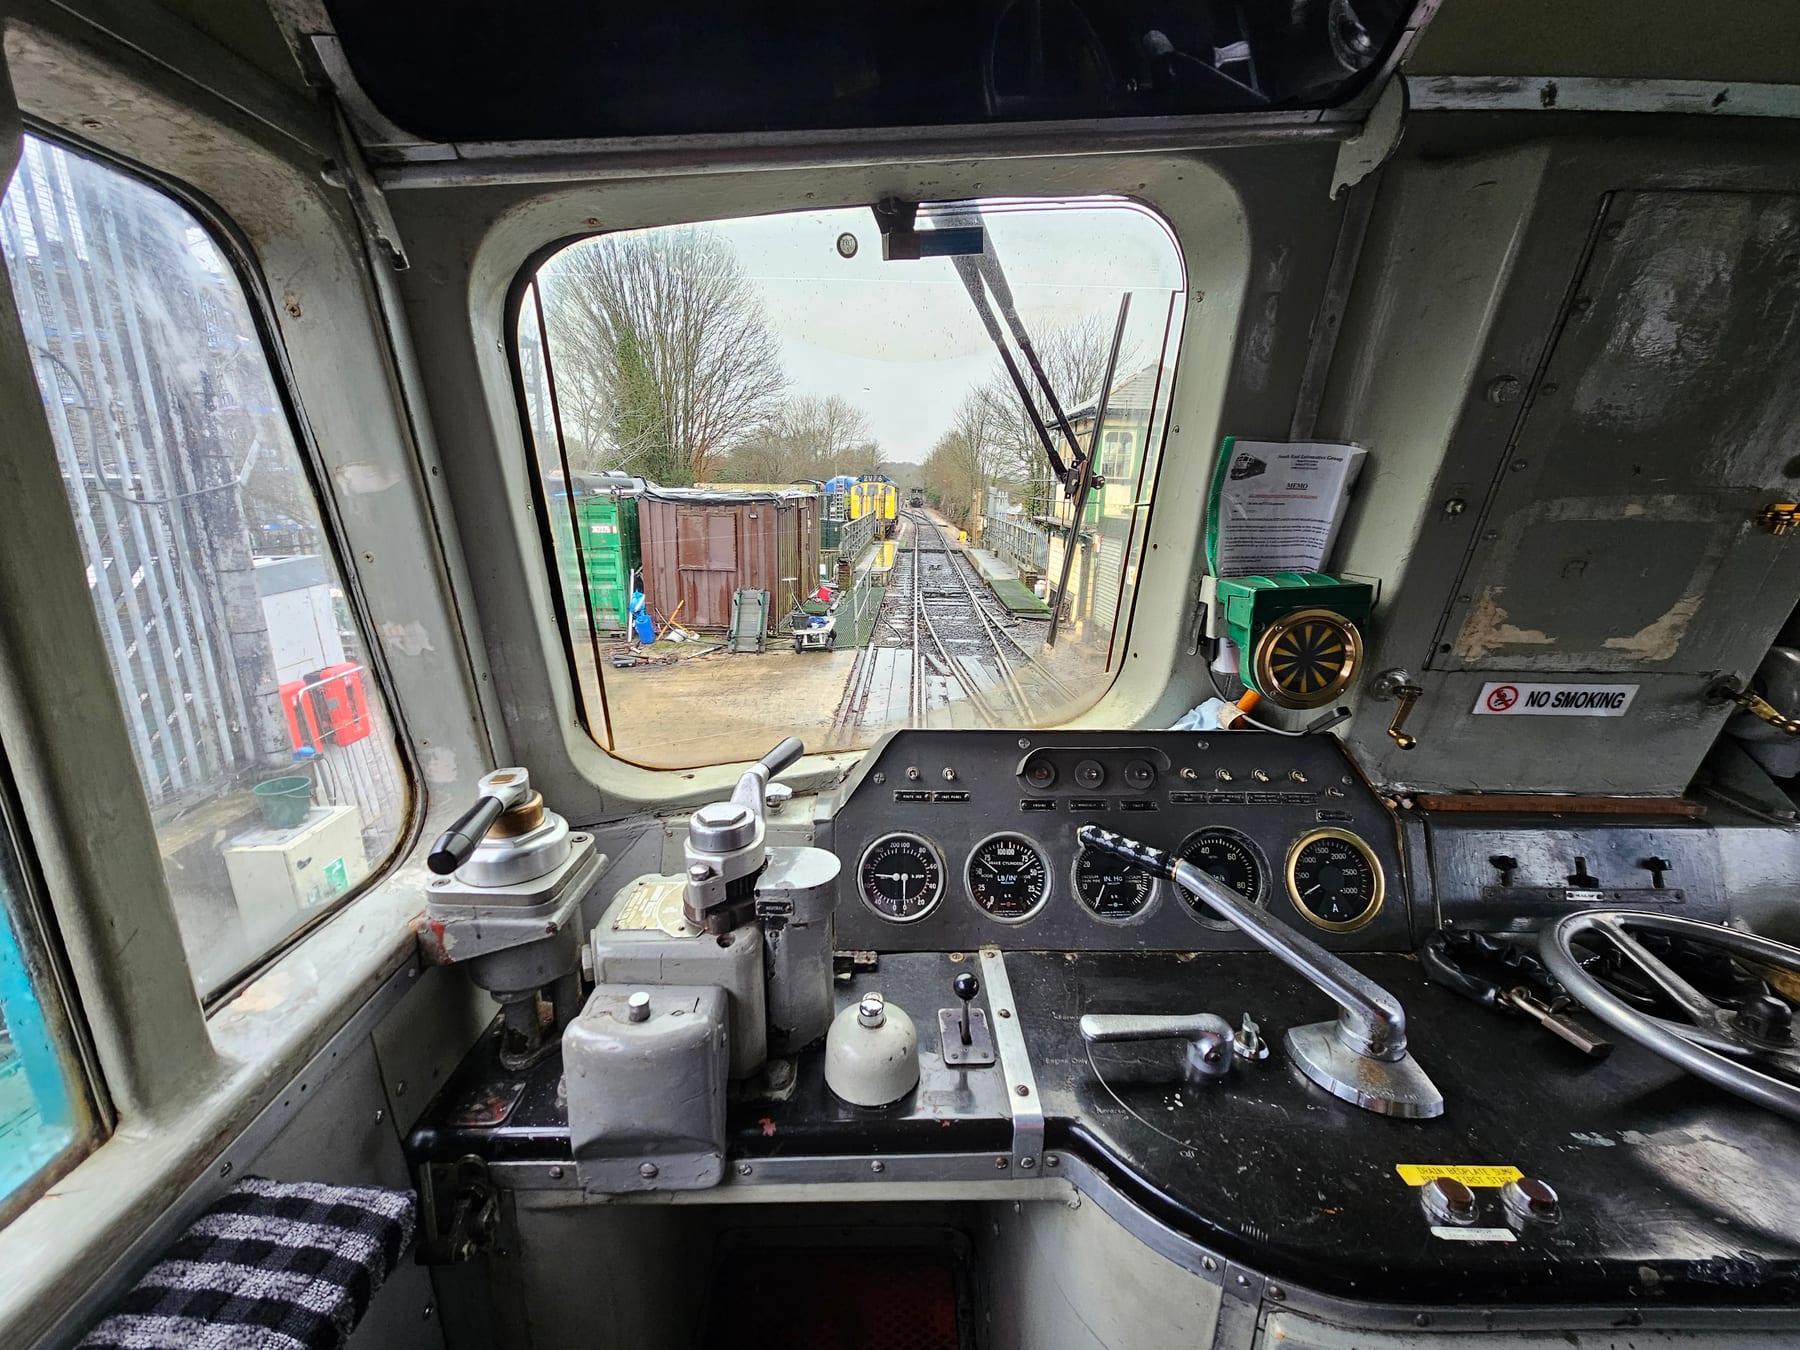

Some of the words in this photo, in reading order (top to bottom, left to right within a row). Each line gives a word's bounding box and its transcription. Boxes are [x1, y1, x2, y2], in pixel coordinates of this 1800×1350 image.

[1286, 482, 1309, 490] MEMO
[1525, 691, 1550, 708] NO
[1551, 691, 1626, 709] SMOKING
[1200, 846, 1210, 854] 40
[1332, 903, 1339, 912] A
